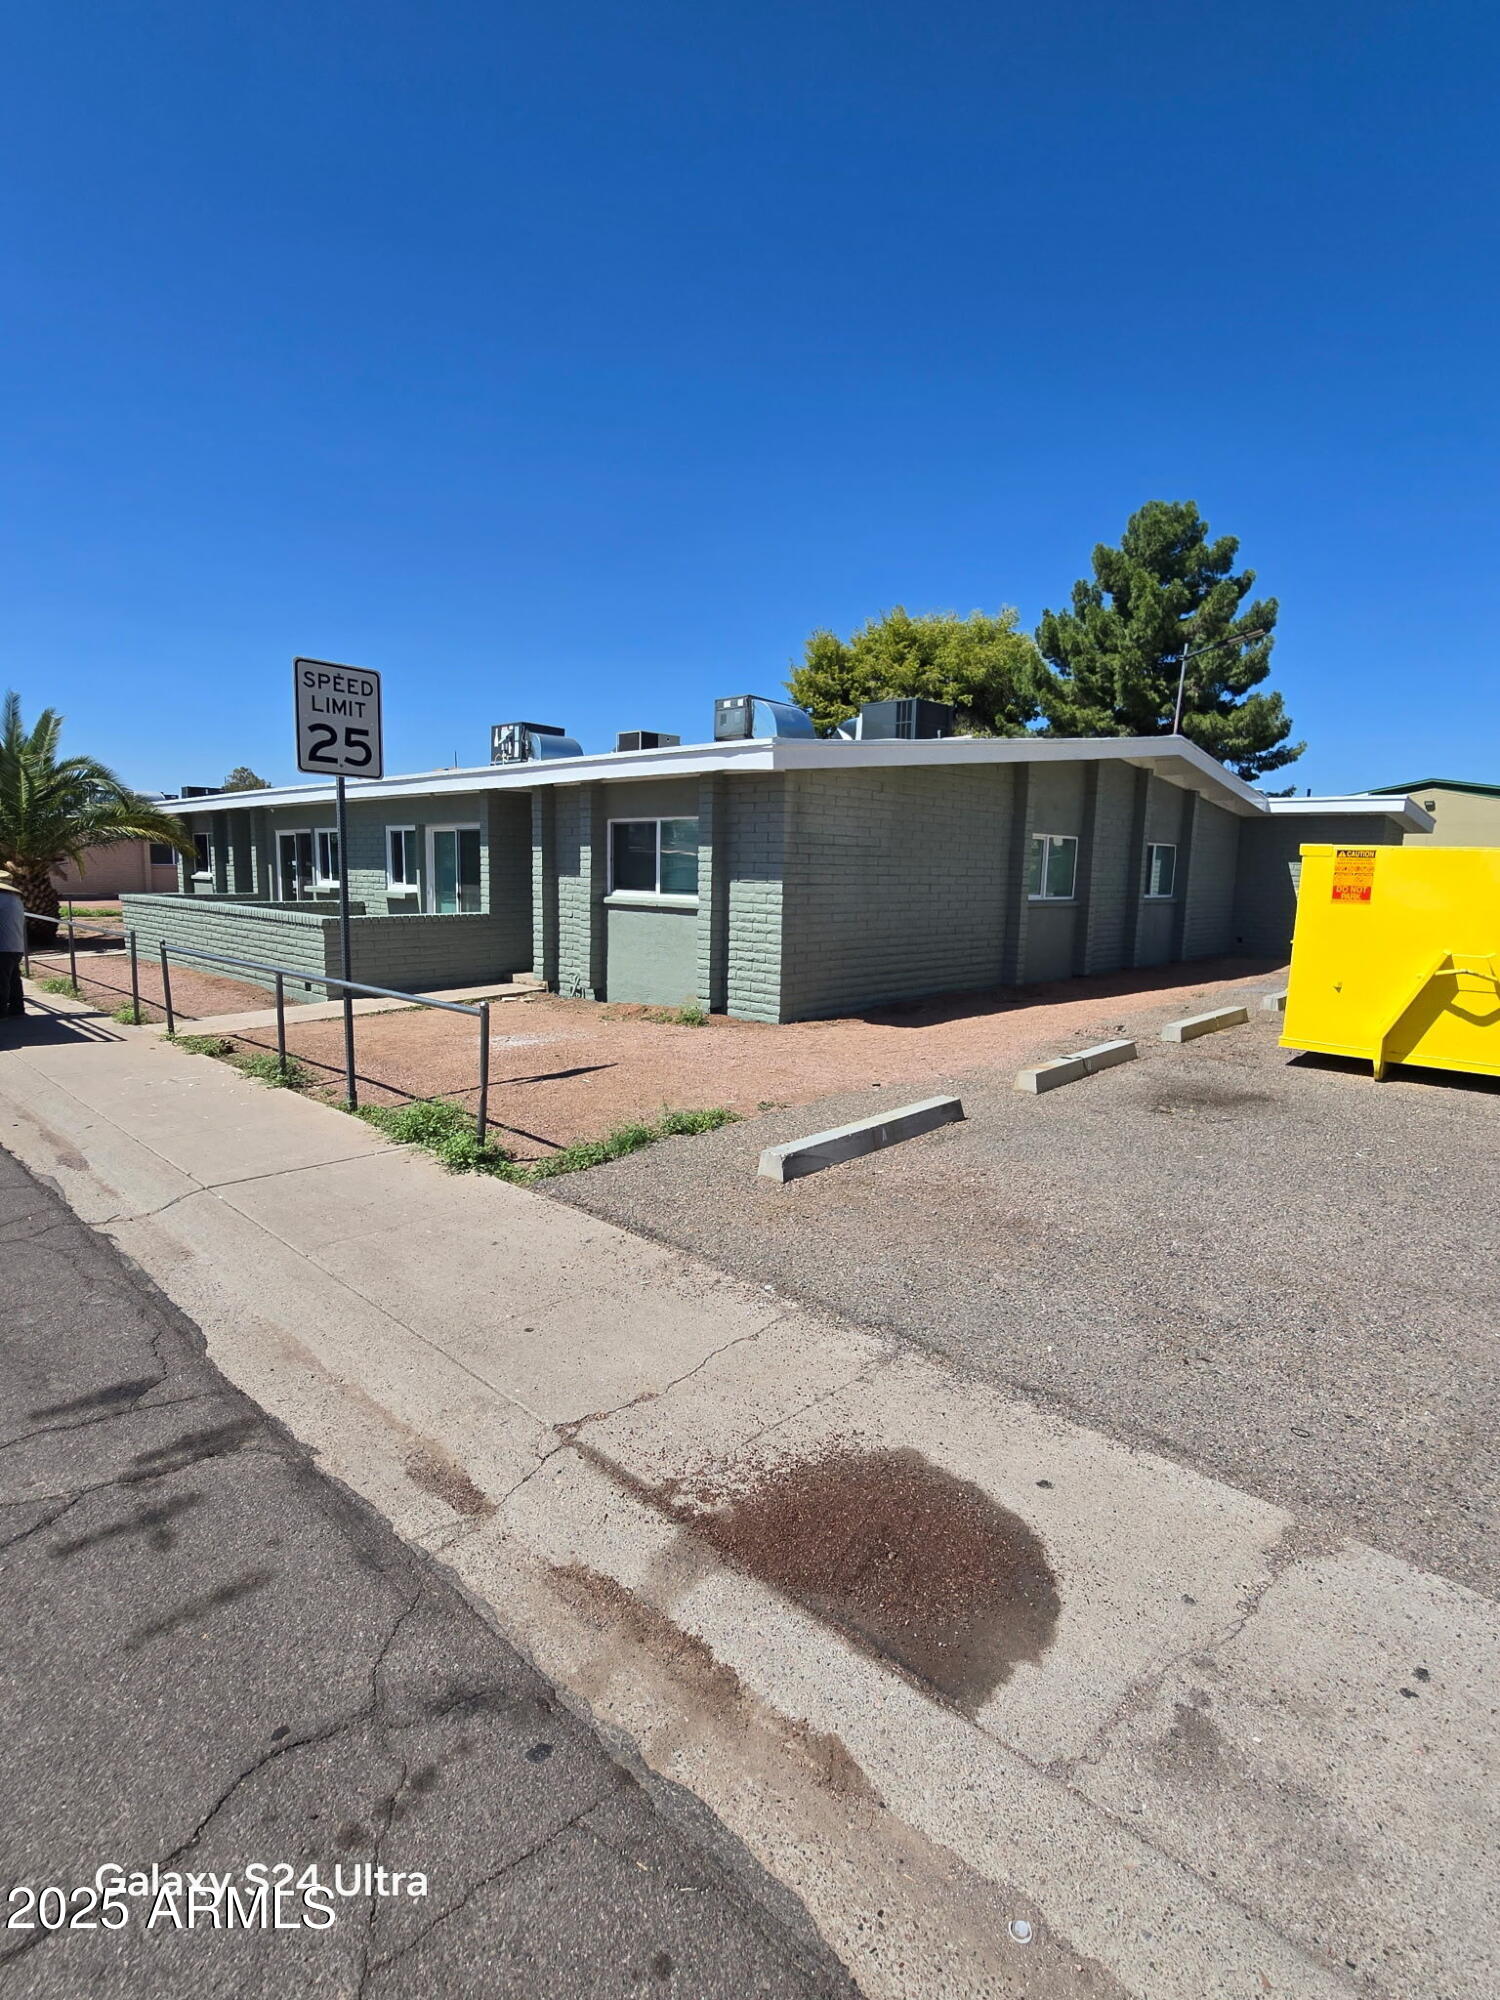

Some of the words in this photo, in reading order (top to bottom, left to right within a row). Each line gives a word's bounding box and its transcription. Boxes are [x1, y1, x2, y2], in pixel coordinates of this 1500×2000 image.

[303, 671, 374, 697] SPEED
[311, 694, 367, 718] LIMIT
[307, 723, 373, 767] 25
[1351, 886, 1367, 894] NOT
